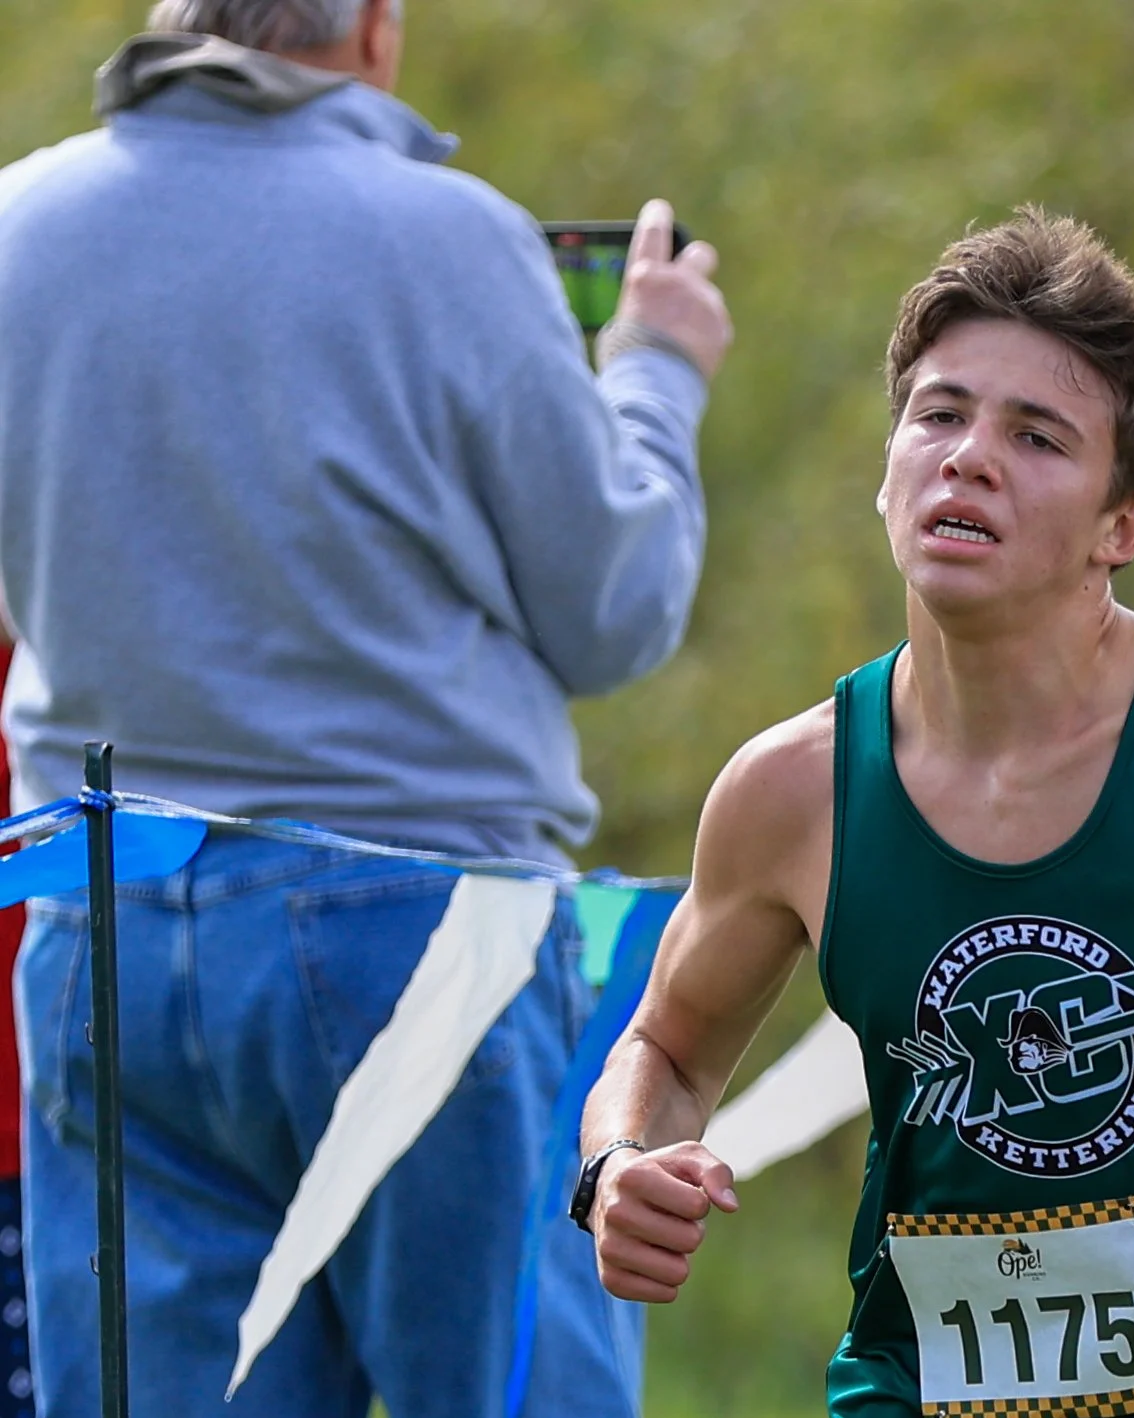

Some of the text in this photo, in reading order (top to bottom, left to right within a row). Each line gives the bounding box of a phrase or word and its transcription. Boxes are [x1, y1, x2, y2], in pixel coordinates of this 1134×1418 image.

[924, 924, 1110, 1011] WATERFORD
[940, 971, 1133, 1127] XC
[997, 1249, 1042, 1280] Ope!
